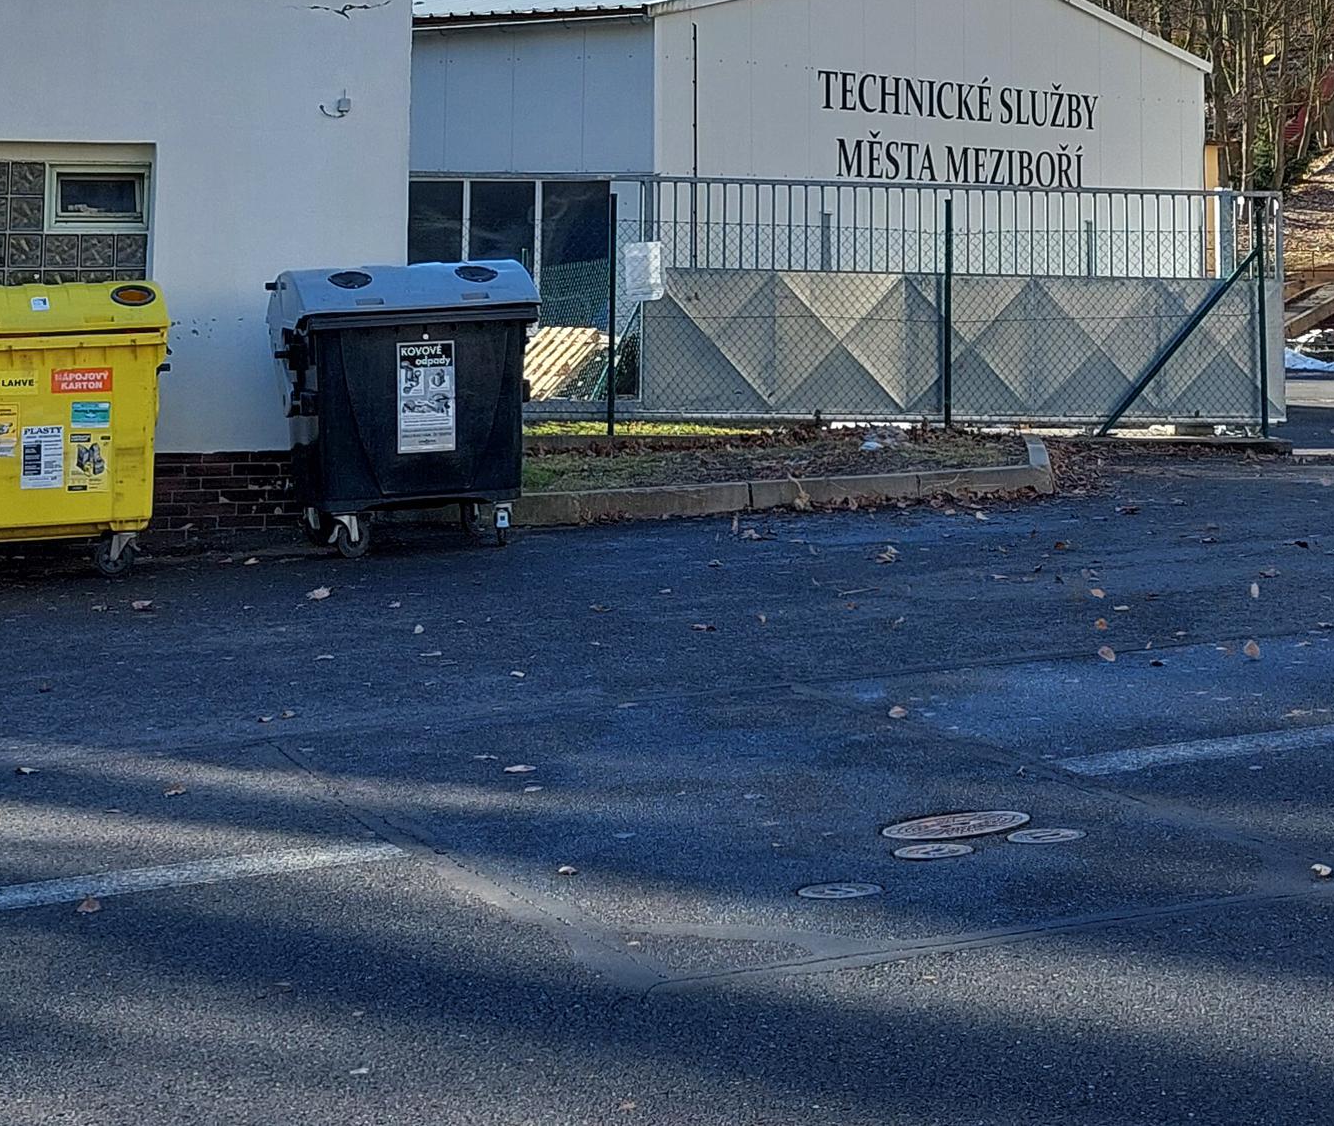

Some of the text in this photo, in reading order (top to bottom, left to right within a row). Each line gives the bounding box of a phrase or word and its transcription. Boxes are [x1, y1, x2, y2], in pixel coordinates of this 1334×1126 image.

[817, 70, 1099, 130] TECHNICKÉ SLUŽBY
[836, 130, 1085, 188] MĚSTA MEZIBOŘÍ
[400, 343, 442, 356] KOVOVÉ
[415, 355, 451, 366] odpady
[1, 379, 35, 387] LAHVE
[61, 381, 103, 390] KARTON
[23, 426, 63, 435] PLASTY
